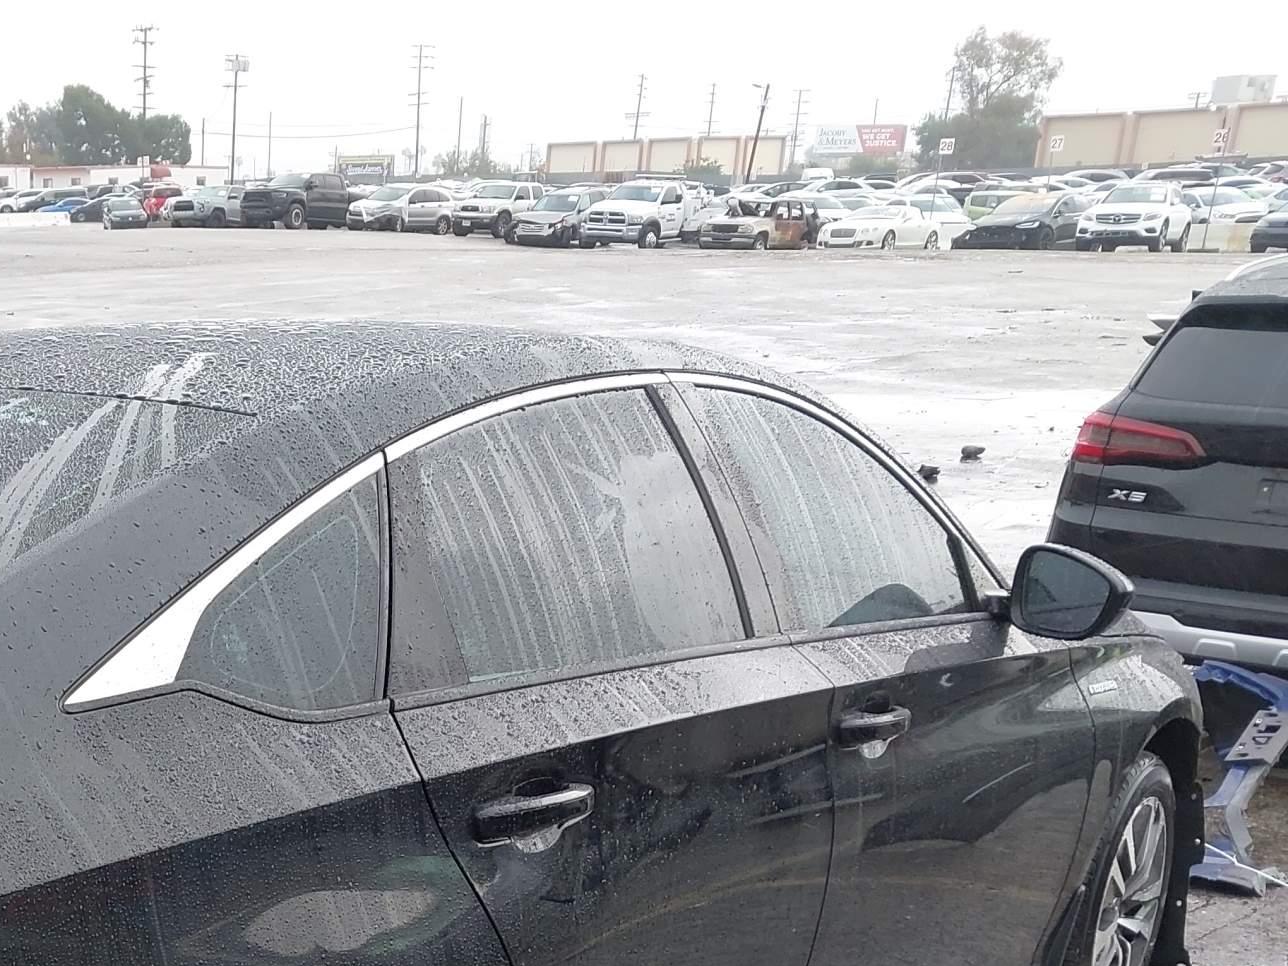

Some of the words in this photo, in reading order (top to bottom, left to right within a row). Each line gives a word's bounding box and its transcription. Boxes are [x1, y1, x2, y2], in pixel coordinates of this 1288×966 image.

[940, 140, 953, 151] 28
[1051, 138, 1064, 149] 27
[1107, 488, 1148, 502] X5
